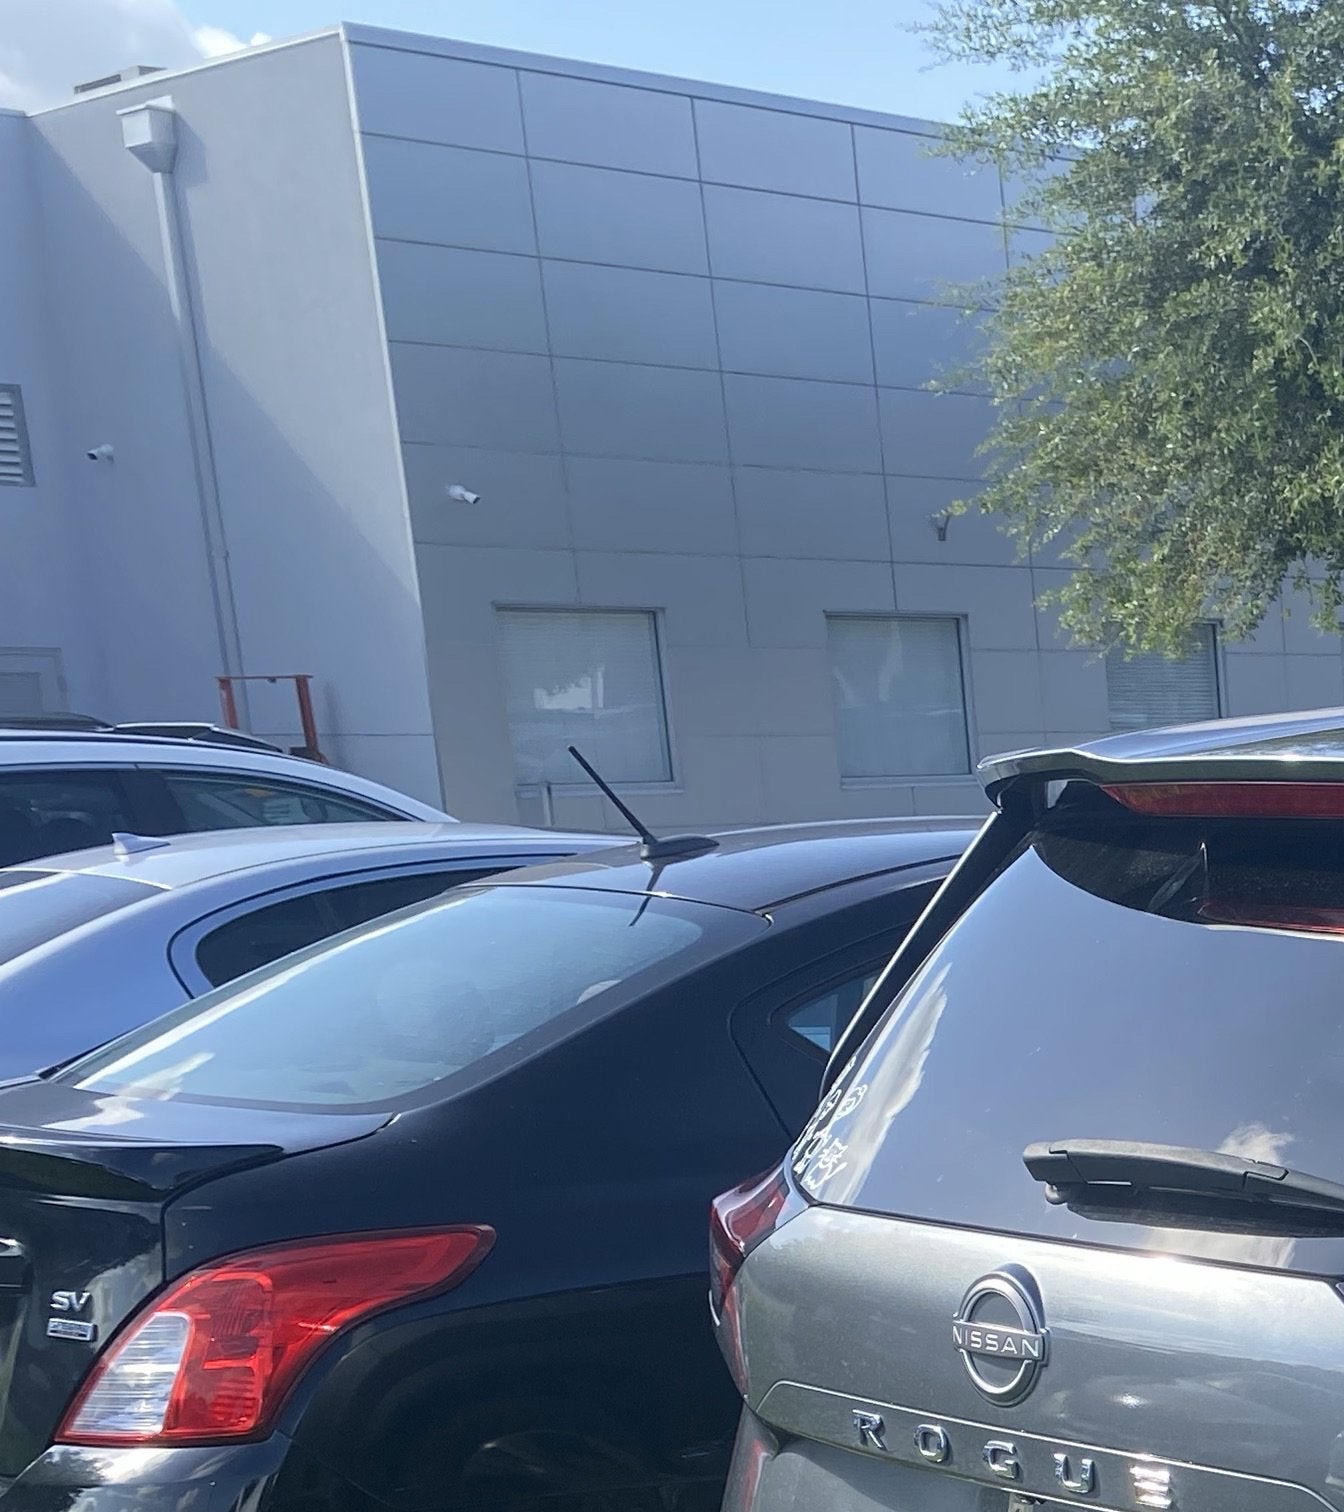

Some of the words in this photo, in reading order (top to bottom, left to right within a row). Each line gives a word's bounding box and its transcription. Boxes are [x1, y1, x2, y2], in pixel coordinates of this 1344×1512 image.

[50, 1290, 91, 1312] SV
[952, 1323, 1041, 1360] NISSAN
[851, 1408, 1174, 1510] ROGUE
